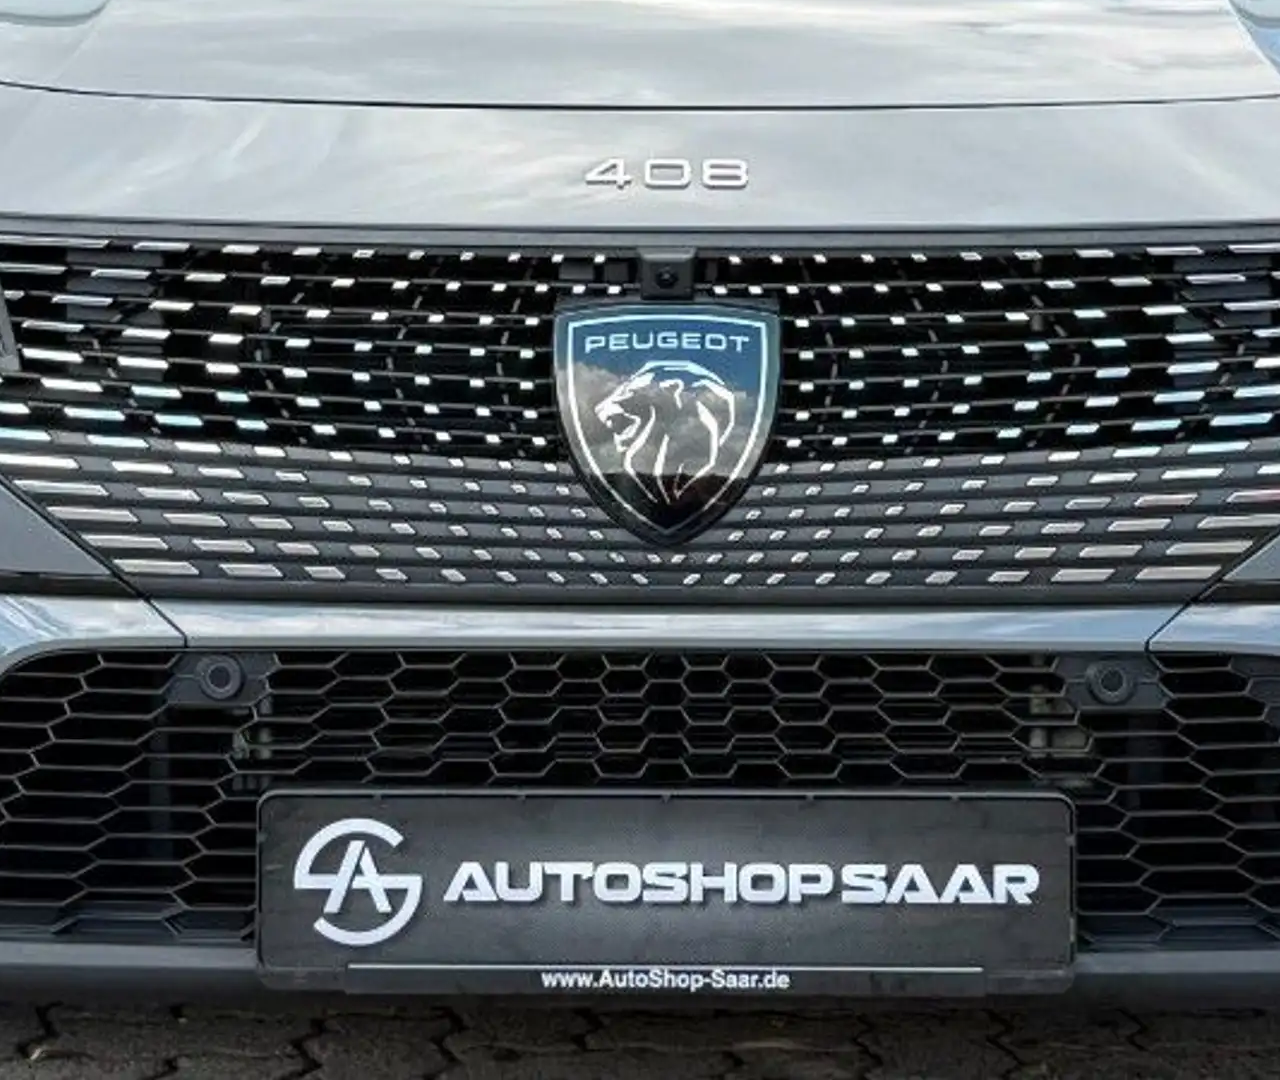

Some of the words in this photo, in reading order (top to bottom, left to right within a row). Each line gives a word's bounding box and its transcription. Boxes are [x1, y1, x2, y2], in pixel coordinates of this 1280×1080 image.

[584, 158, 749, 191] 408
[584, 330, 750, 354] PEUGEOT
[540, 969, 791, 992] www.AutoShop-Saar.de
